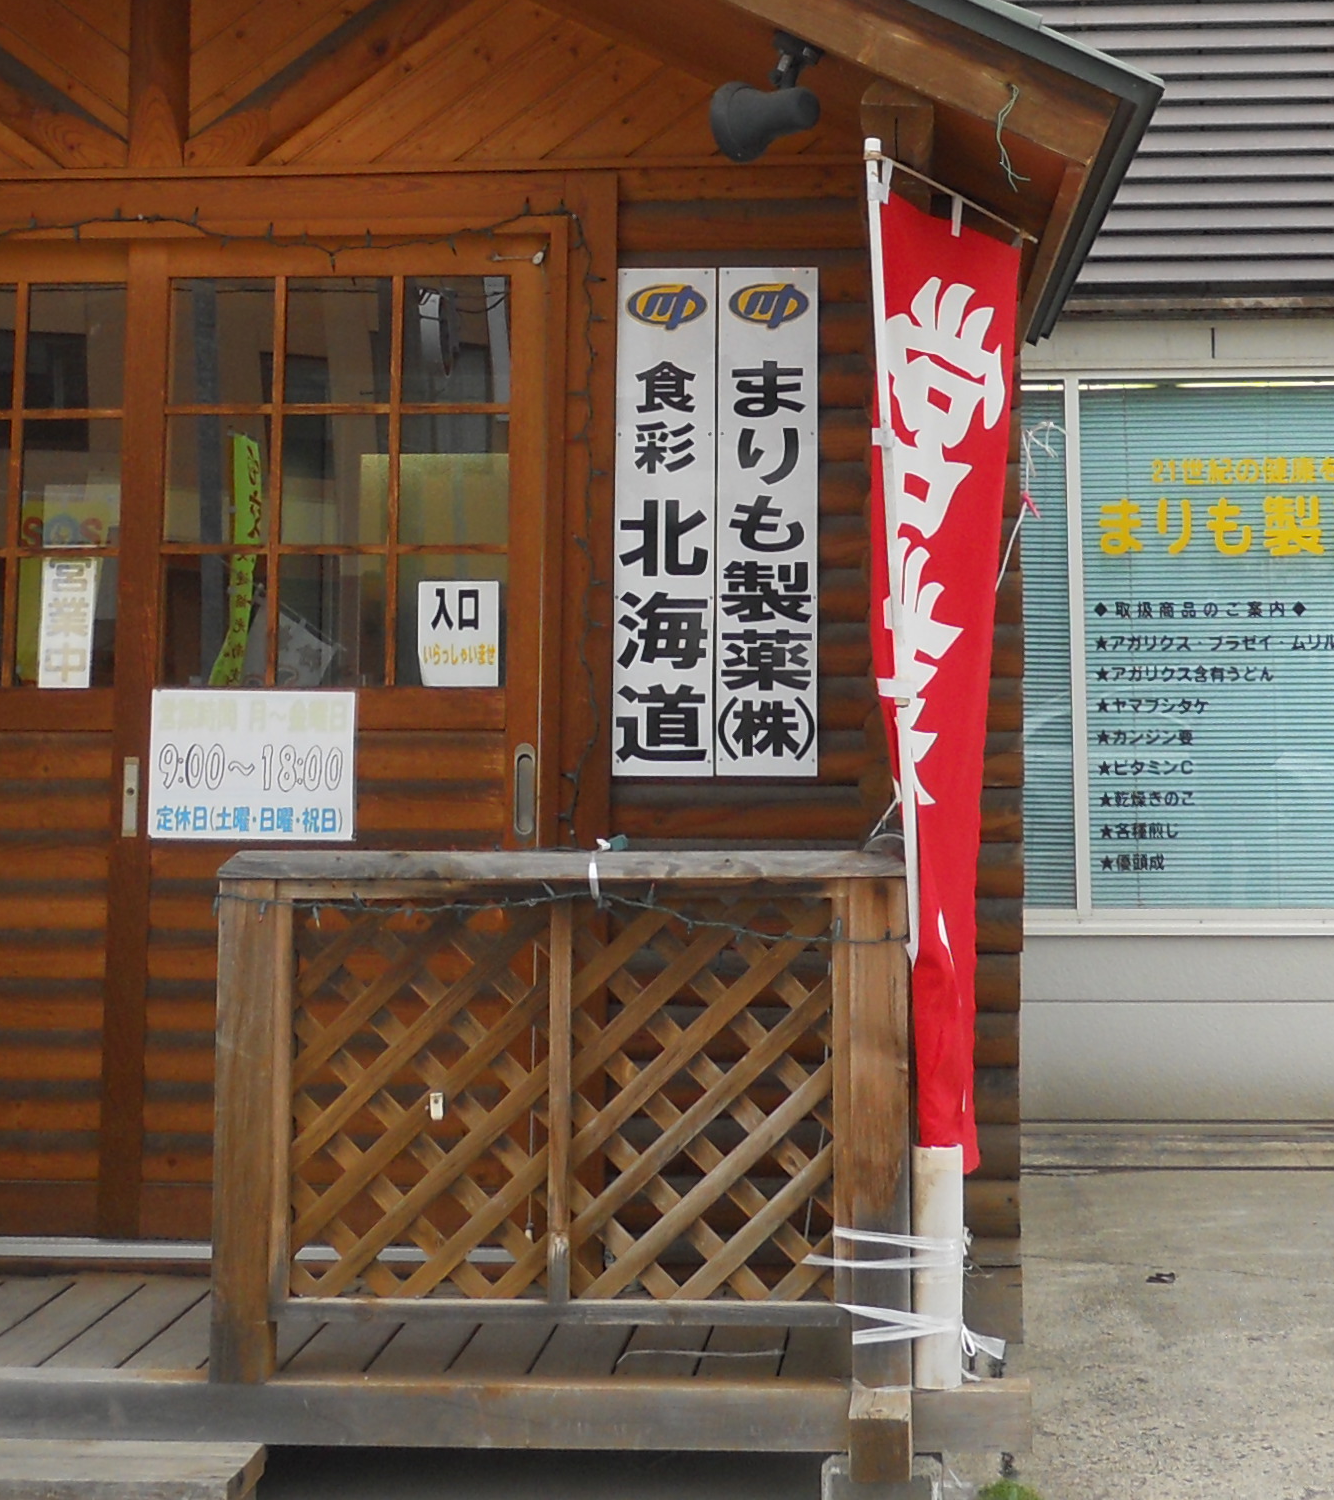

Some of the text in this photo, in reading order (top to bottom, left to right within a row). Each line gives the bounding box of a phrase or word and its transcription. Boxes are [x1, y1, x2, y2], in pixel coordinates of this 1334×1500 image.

[615, 359, 709, 763] 食彩 北海道
[717, 359, 816, 762] まりも製薬(株)
[430, 587, 479, 631] 入口
[882, 276, 1007, 970] 営業
[423, 643, 496, 666] いらっしゃいませ
[1111, 665, 1275, 684] アガリクス含有うどん
[1114, 759, 1194, 776] ビタミンC
[1114, 791, 1196, 807] 乾燥きのこ
